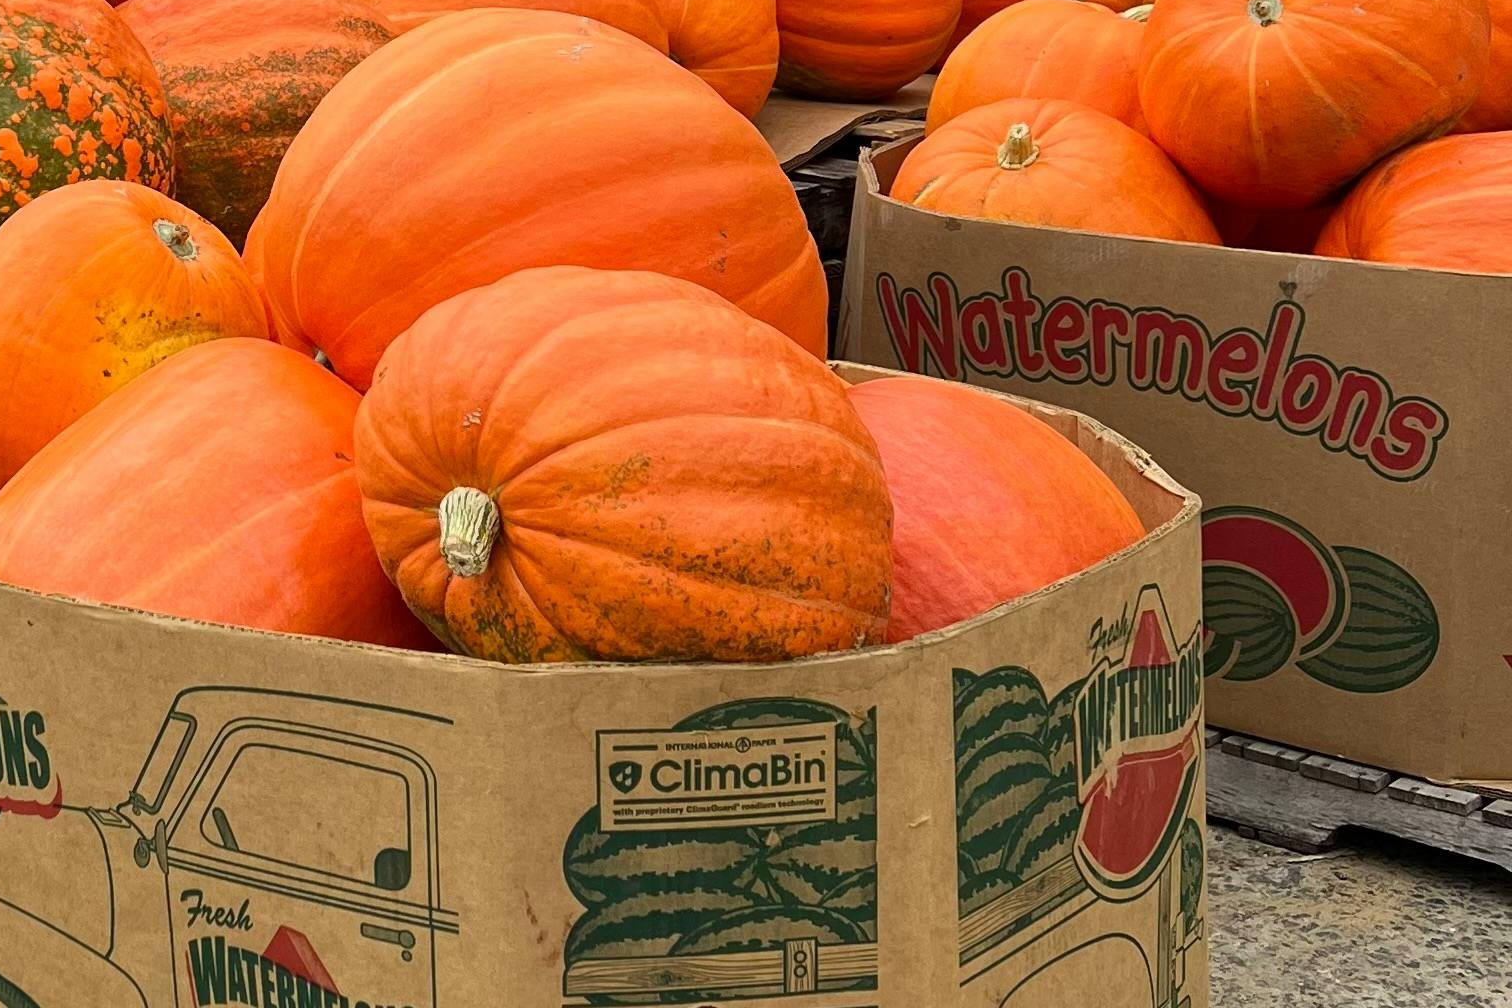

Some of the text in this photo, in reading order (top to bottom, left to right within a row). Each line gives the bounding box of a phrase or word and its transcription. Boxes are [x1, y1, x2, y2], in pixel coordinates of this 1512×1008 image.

[876, 266, 1449, 483] Watermelons
[1087, 601, 1129, 665] Fresh
[1077, 631, 1201, 786] WATERMELONS
[751, 738, 777, 748] PAPER
[613, 807, 634, 817] with
[636, 805, 684, 817] proprietary
[778, 797, 825, 809] technology
[180, 888, 254, 932] Fresh
